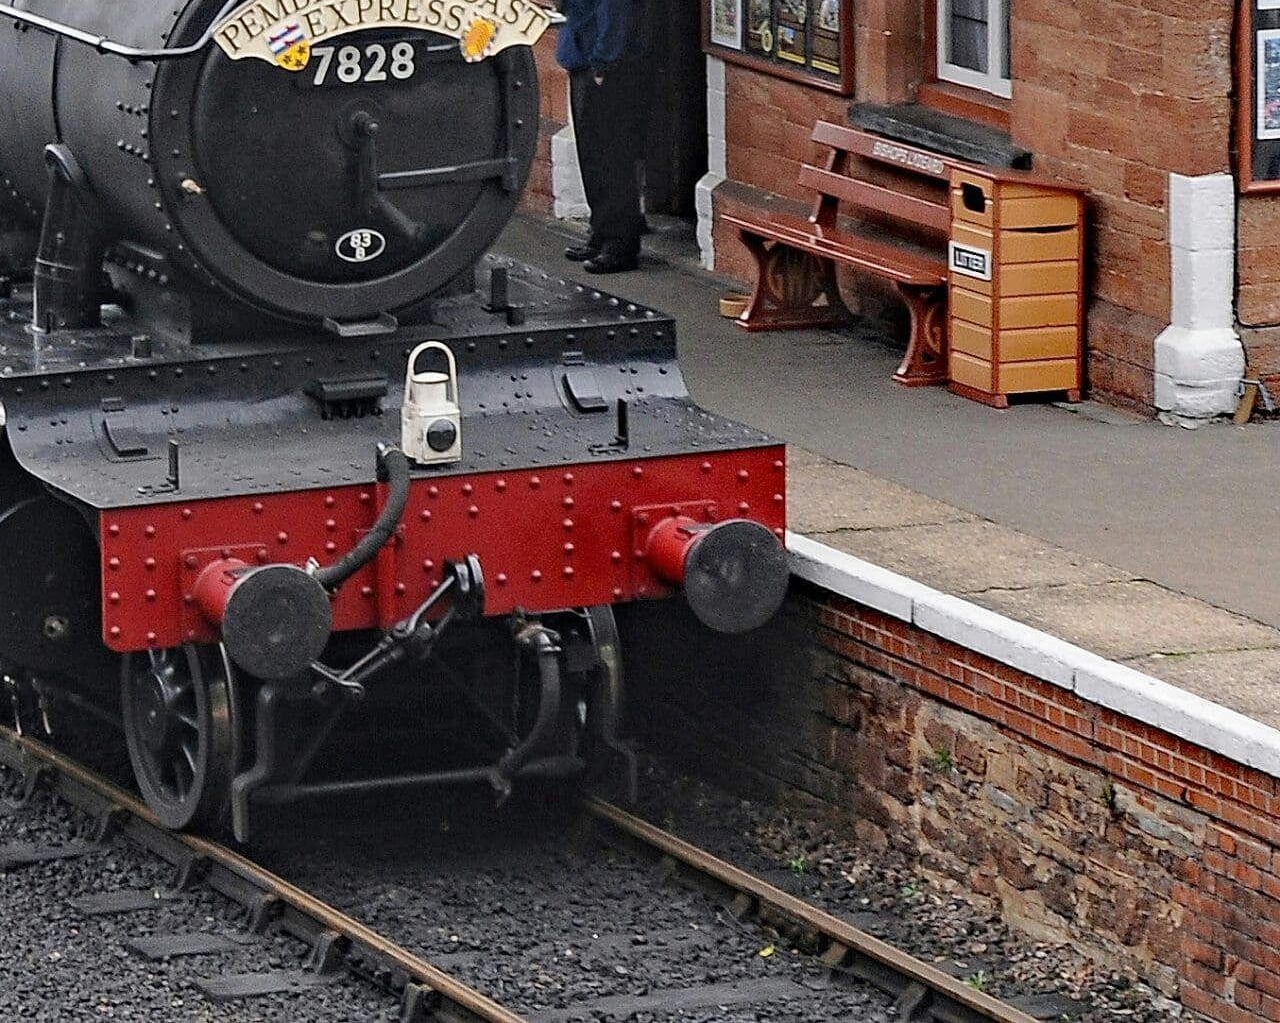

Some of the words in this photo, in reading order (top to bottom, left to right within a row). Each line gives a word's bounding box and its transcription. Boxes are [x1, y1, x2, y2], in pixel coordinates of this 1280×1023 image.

[311, 41, 416, 86] 7828
[350, 233, 372, 248] 83
[955, 249, 986, 271] LITTER
